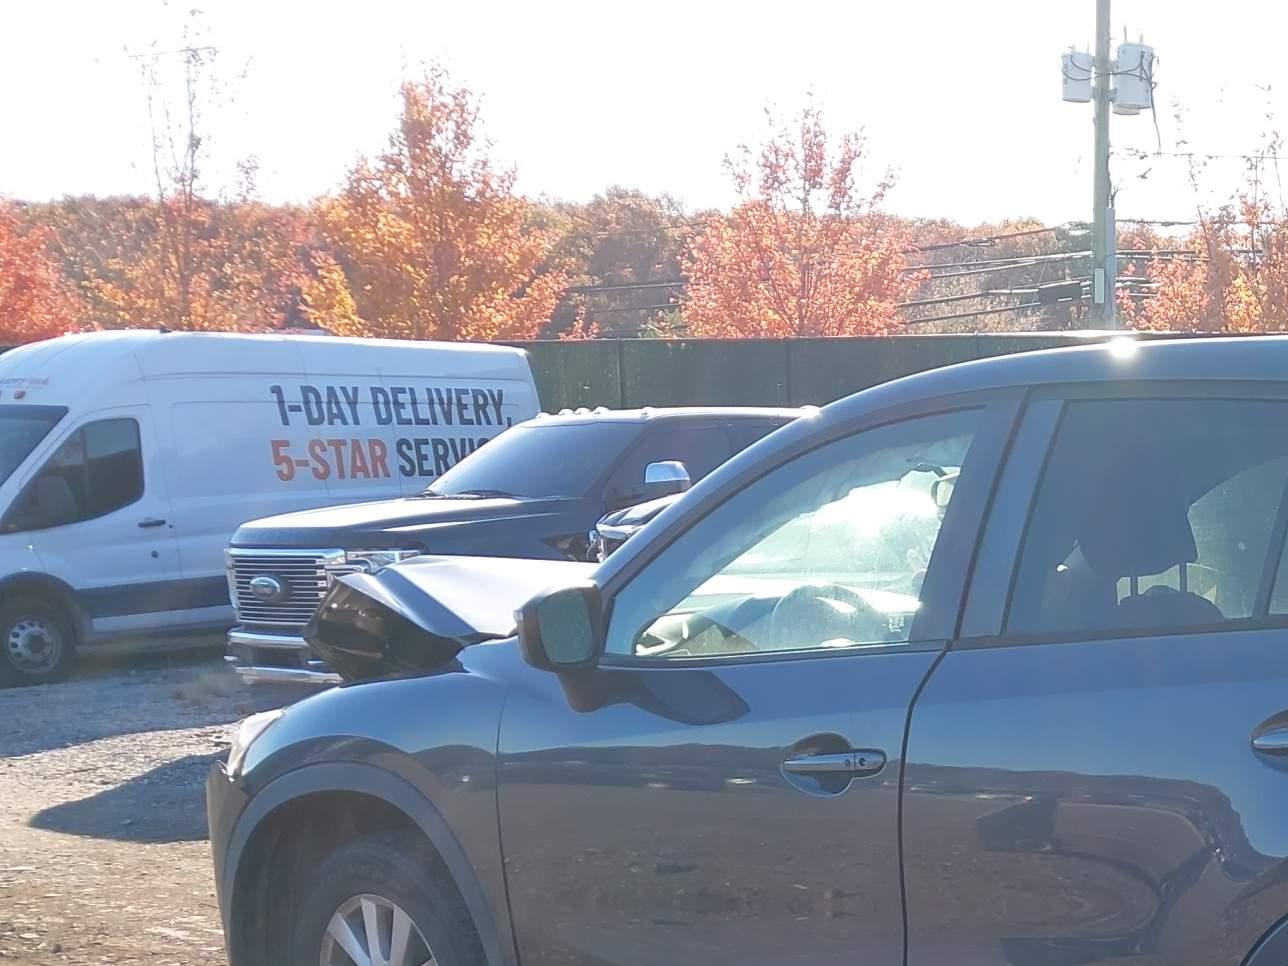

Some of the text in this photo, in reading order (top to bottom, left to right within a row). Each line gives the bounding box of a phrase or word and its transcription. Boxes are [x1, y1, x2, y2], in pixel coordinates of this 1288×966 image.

[270, 385, 512, 428] 1-DAY DELIVERY,
[271, 437, 489, 481] 5-STAR SERV
